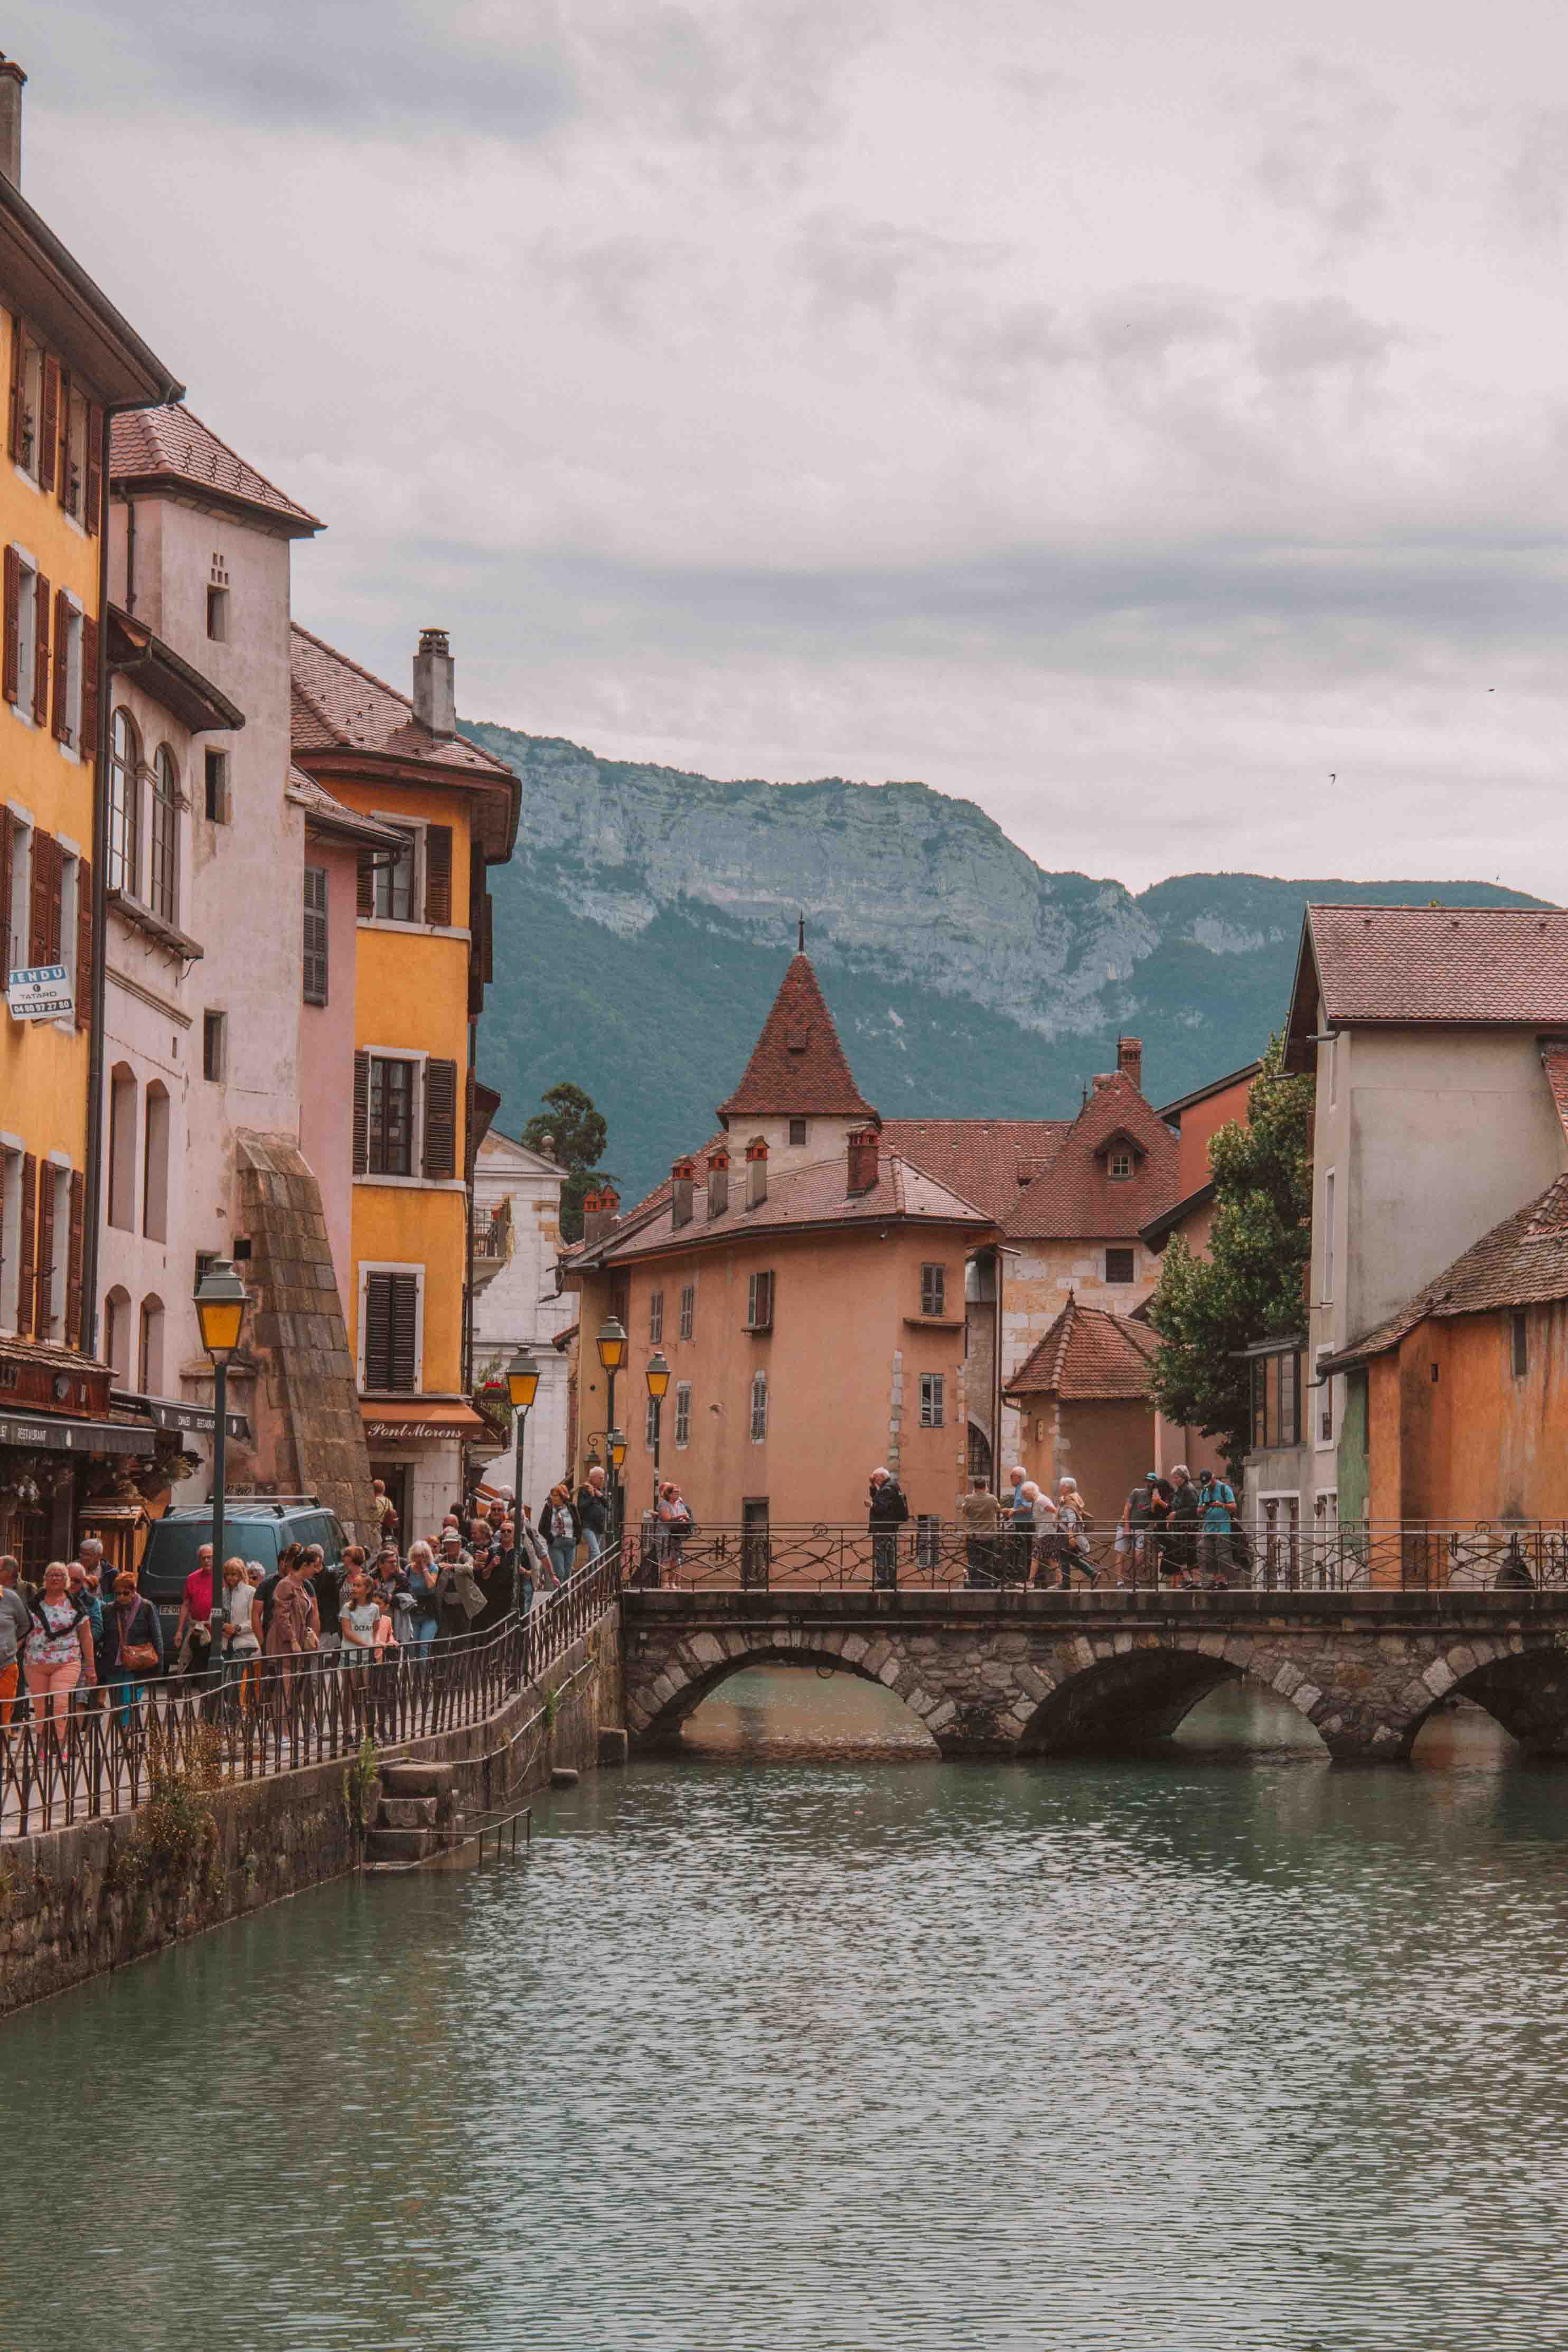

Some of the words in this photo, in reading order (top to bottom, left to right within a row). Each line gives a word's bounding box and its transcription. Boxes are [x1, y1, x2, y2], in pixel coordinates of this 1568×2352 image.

[17, 1428, 46, 1441] RESTAURANT
[368, 1423, 408, 1437] Pont
[408, 1423, 465, 1438] Morens
